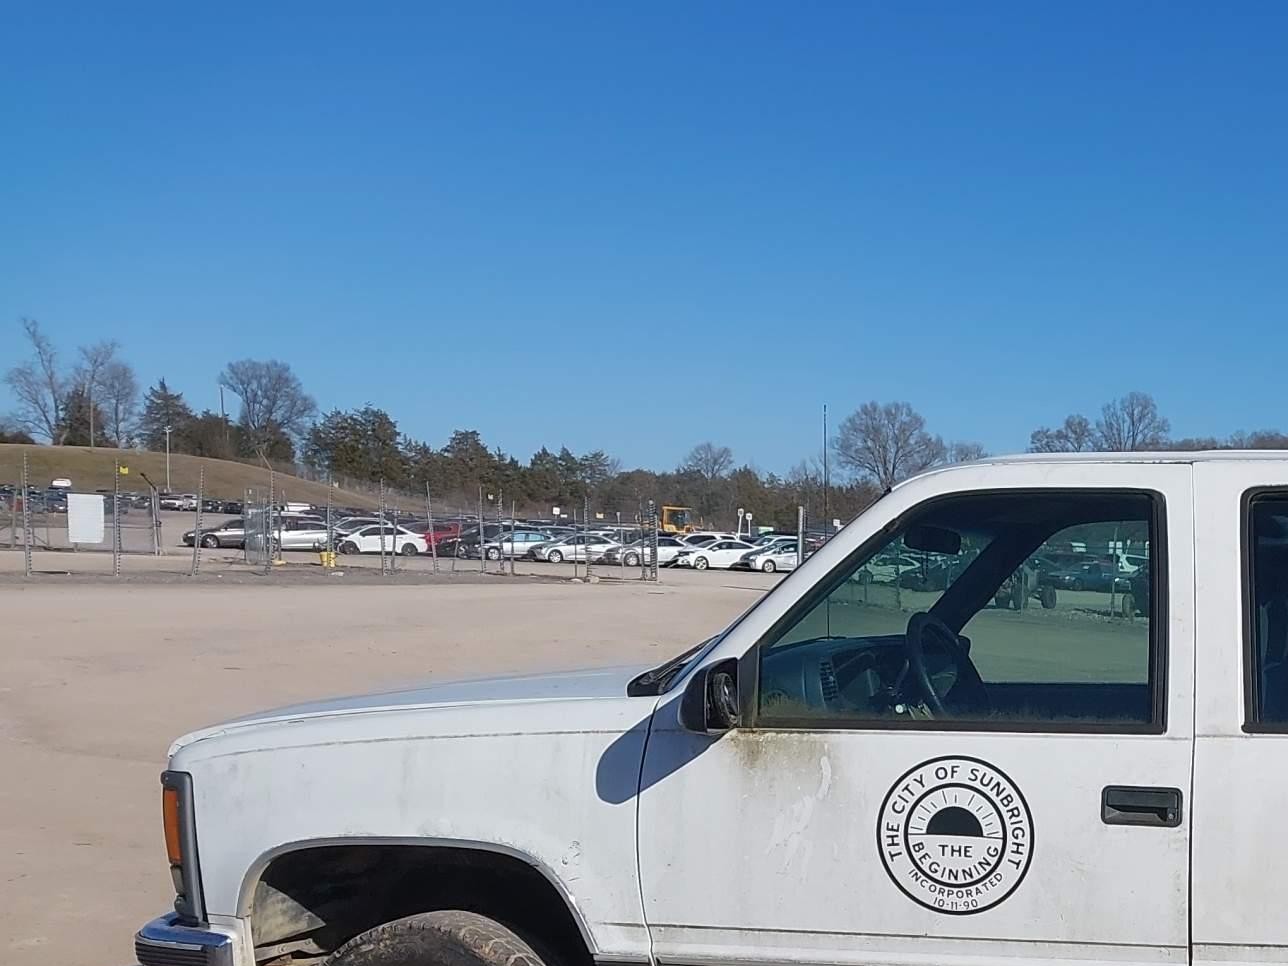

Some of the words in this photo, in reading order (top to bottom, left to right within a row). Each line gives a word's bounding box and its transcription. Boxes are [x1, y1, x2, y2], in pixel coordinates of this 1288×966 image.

[934, 765, 960, 780] OF
[891, 773, 926, 815] CITY
[967, 768, 1026, 870] SUNBRIGHT
[885, 821, 903, 862] THE
[938, 844, 973, 858] THE
[912, 841, 999, 881] BEGINNING
[908, 868, 1003, 899] INCORPORATED
[933, 896, 978, 910] 10-11-90
